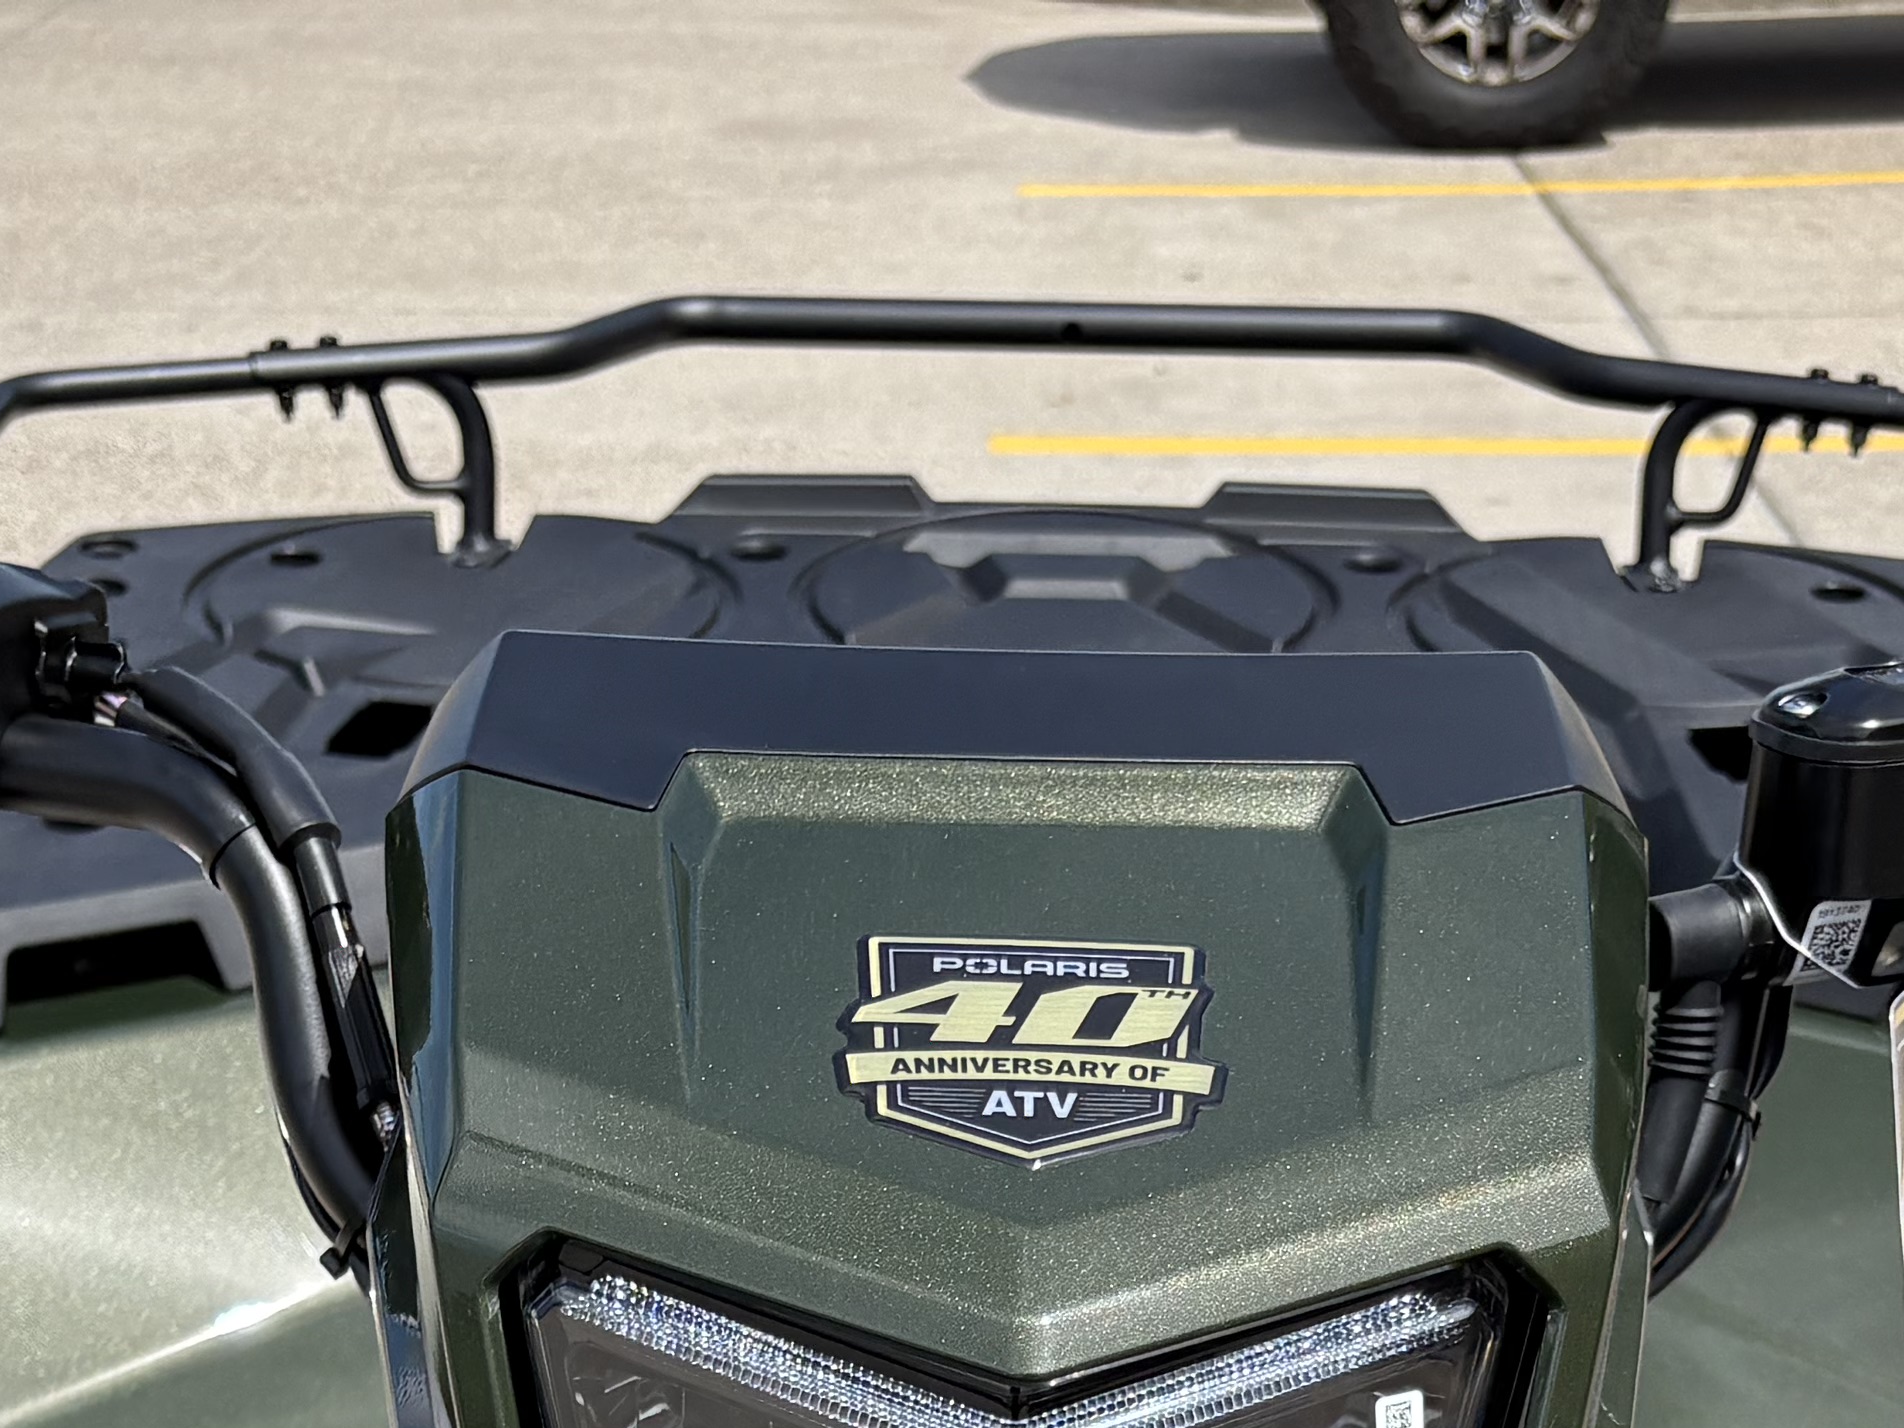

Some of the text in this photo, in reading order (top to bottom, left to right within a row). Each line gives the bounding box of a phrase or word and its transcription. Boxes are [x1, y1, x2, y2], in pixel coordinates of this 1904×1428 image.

[932, 956, 1130, 979] POLARIS
[890, 1056, 1171, 1083] ANNIVERSARY OF
[981, 1090, 1078, 1119] ATV
